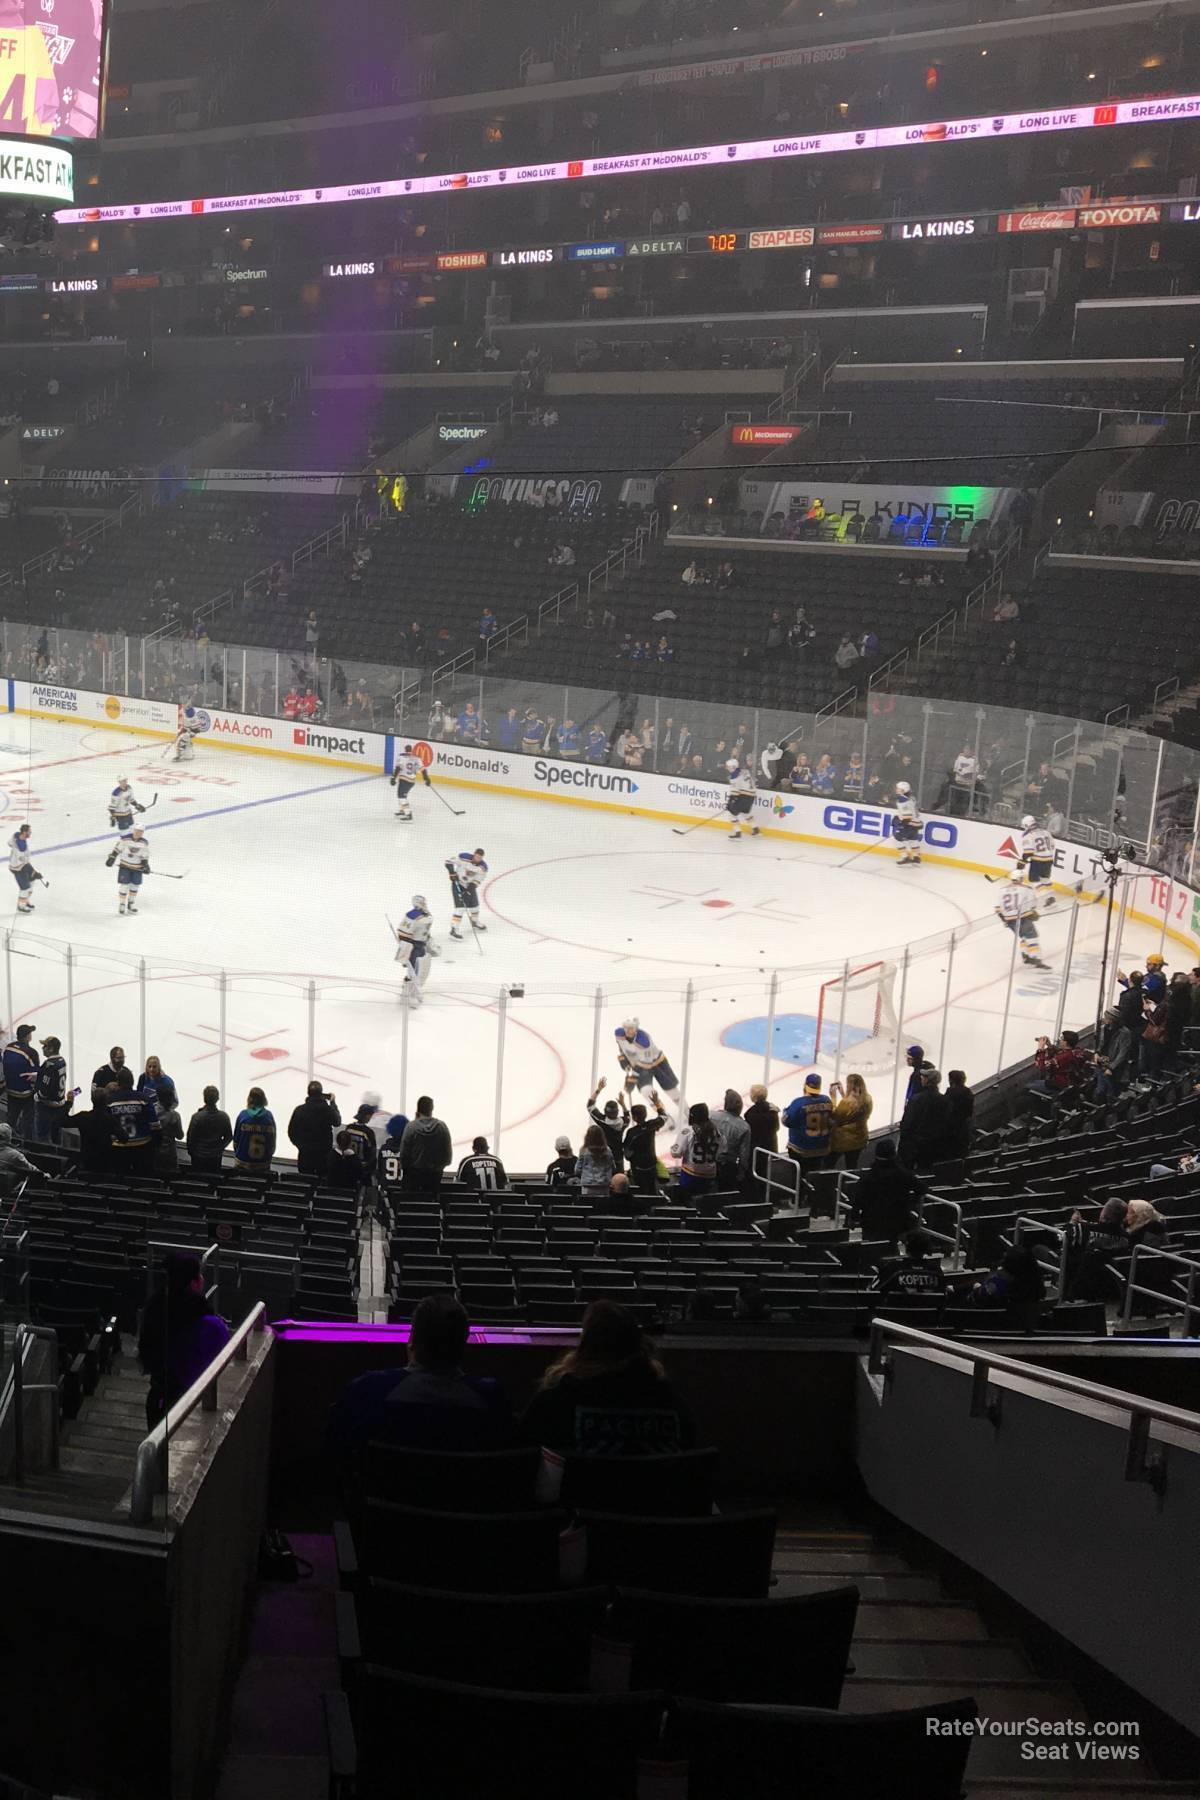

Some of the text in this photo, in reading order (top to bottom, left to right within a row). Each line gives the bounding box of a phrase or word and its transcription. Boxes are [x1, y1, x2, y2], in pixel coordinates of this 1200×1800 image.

[1131, 101, 1200, 118] BREAKFAST
[1019, 114, 1077, 129] LONG LIVE
[773, 139, 822, 153] LONG LIVE
[592, 151, 708, 172] BREAKFAST AT McDONALD'S
[55, 162, 67, 186] AT
[517, 167, 556, 179] LONG LIVE
[347, 186, 381, 197] LONG LIVE
[150, 205, 182, 214] LONG LIVE
[211, 194, 300, 209] BREAKFAST AT McDONALD'S
[1019, 212, 1068, 230] Coca-Cola
[1081, 206, 1160, 226] TOYOTA
[1183, 204, 1200, 222] LA
[903, 219, 975, 239] LA KINGS
[642, 240, 682, 253] DELTA
[707, 234, 736, 251] 7:02
[751, 229, 812, 248] STAPLES
[437, 253, 486, 267] TOSHIBA
[500, 249, 553, 265] LA KINGS
[576, 246, 615, 257] BUD LIGHT
[226, 268, 267, 283] Spectrum
[329, 262, 375, 277] LA KINGS
[52, 281, 64, 293] LA
[66, 279, 98, 291] KINGS
[875, 500, 974, 520] KINGS
[32, 686, 77, 701] AMERICAN
[38, 698, 78, 711] EXPRESS
[212, 717, 273, 739] AAA.com
[306, 727, 365, 756] impact
[437, 751, 511, 775] McDonald's
[534, 760, 632, 793] Spectrum
[667, 783, 721, 800] Children's
[725, 791, 773, 809] Hital
[689, 797, 706, 807] LOS
[823, 805, 958, 849] GEIO
[1003, 893, 1020, 912] 21
[1175, 890, 1188, 920] 7
[385, 1158, 403, 1180] 9
[471, 1160, 498, 1169] KOPITAR
[475, 1167, 498, 1190] 11
